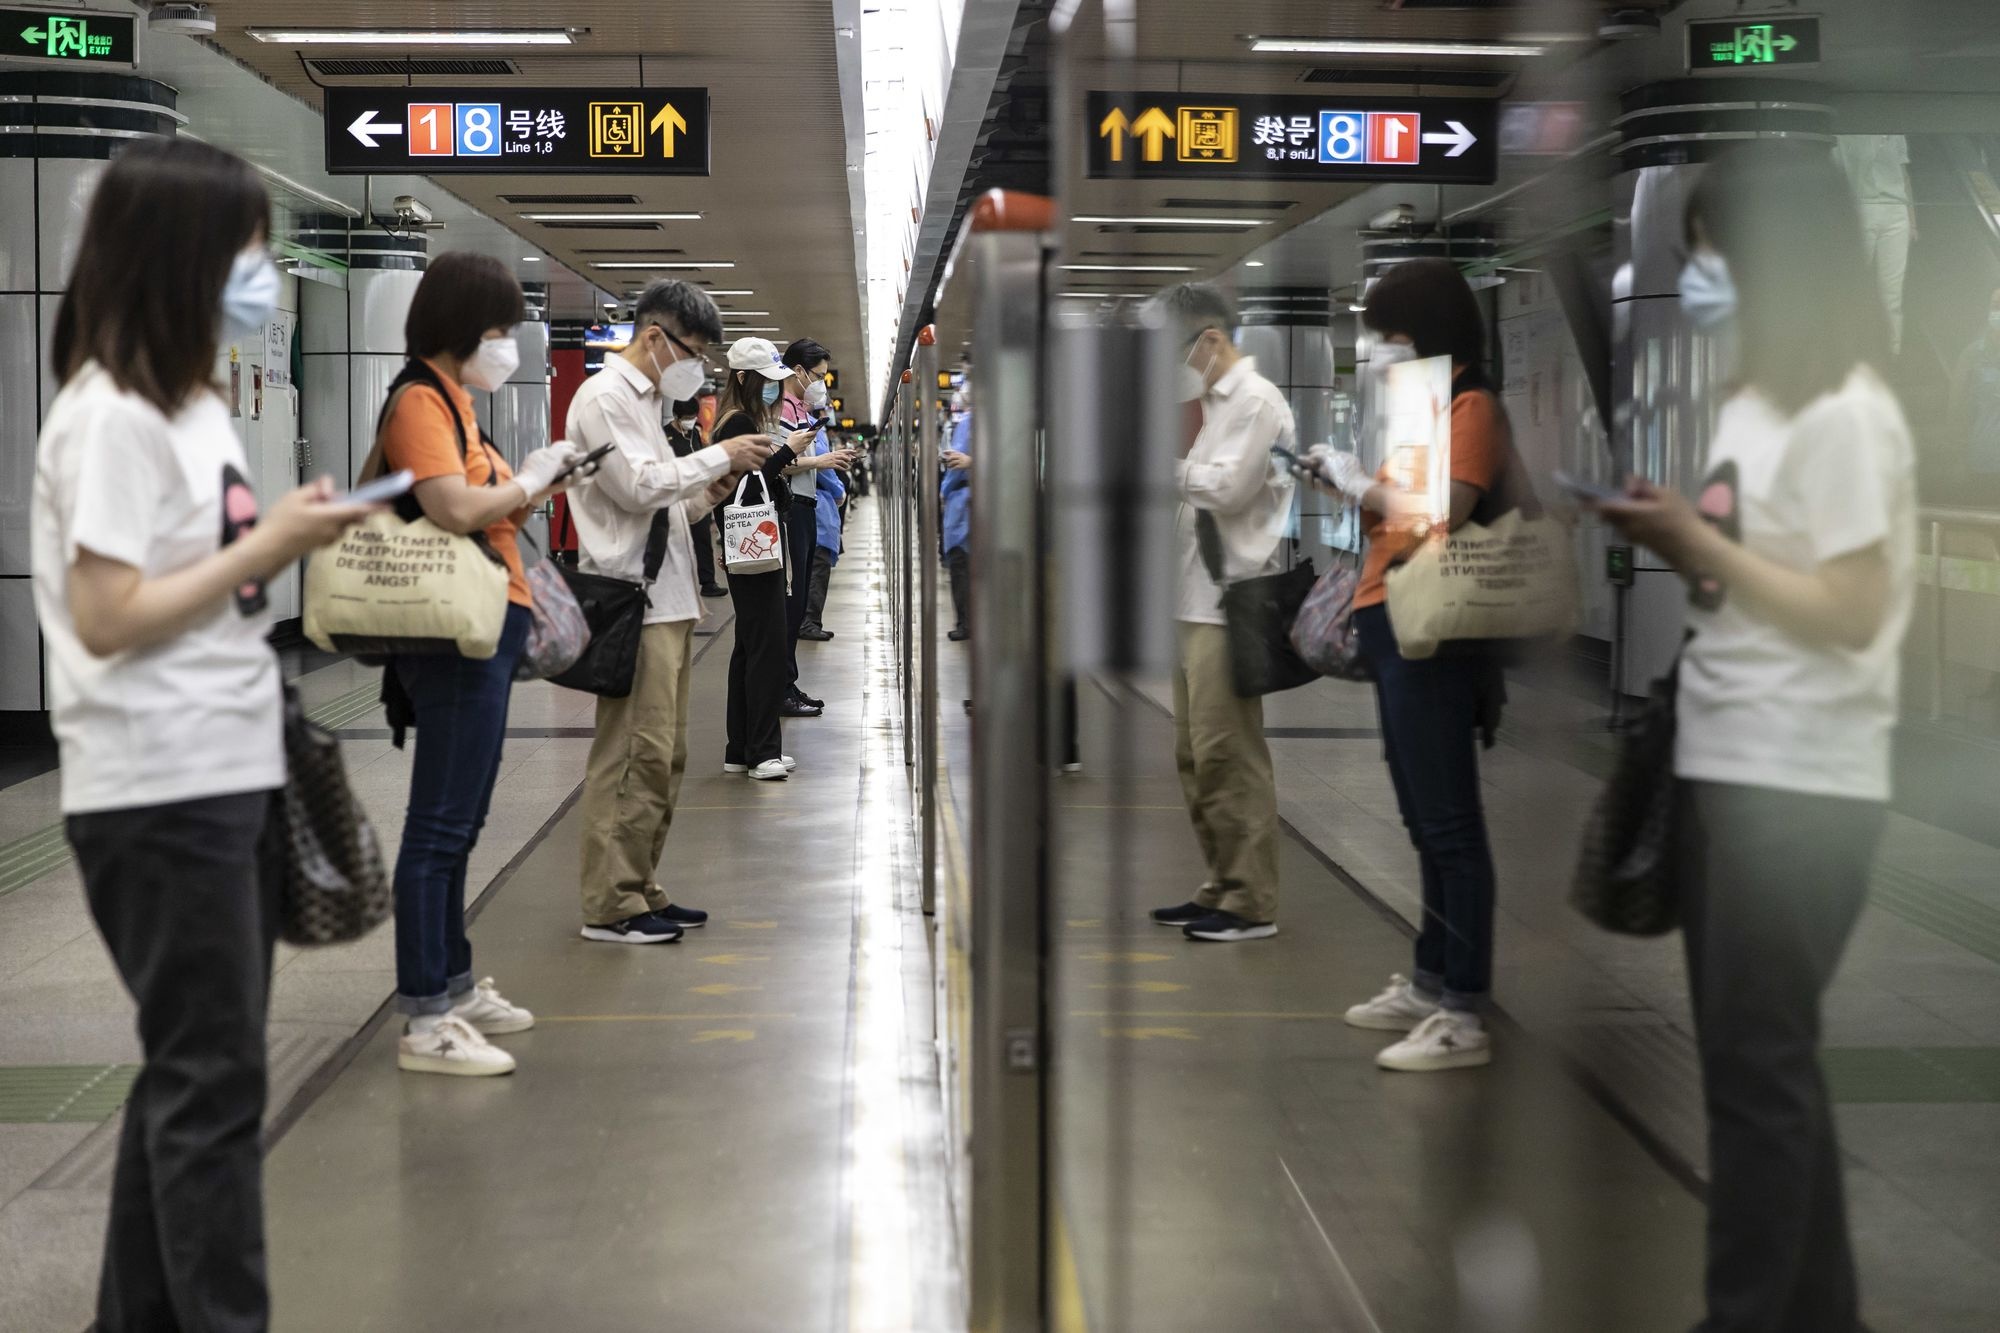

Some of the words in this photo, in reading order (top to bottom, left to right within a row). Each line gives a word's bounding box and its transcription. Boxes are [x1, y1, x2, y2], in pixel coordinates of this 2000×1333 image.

[89, 46, 110, 55] EXIT
[419, 108, 437, 151] 1
[463, 107, 494, 152] 8
[505, 109, 567, 139] 号线
[505, 141, 531, 153] Line
[534, 141, 553, 155] 1,8
[724, 510, 770, 522] INSPIRATION
[725, 521, 736, 530] OF
[737, 520, 752, 528] TEA
[340, 542, 457, 561] MEATPUPPETS
[336, 556, 456, 575] DESCENDENTS
[363, 574, 421, 588] ANGST
